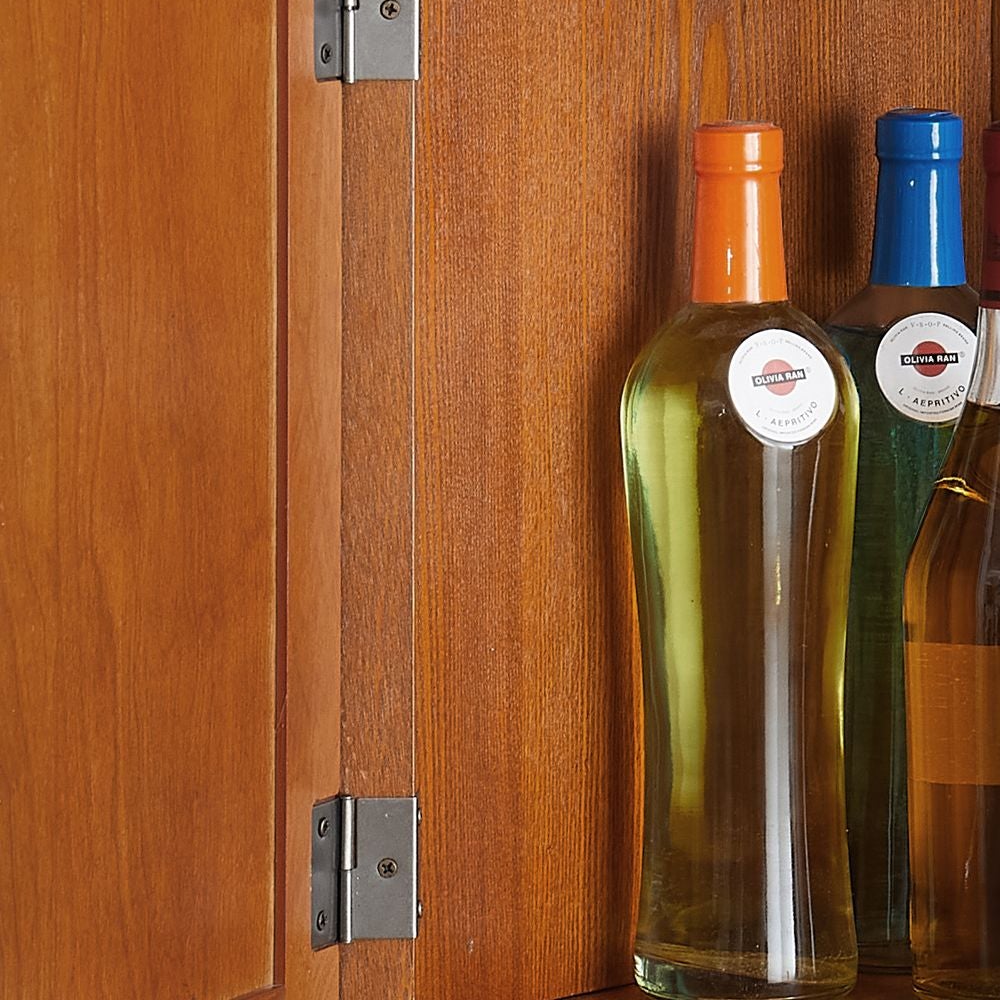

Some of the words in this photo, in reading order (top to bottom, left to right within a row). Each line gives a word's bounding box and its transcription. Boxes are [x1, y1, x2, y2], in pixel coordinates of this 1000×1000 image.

[903, 356, 934, 364] OLIVIA
[936, 354, 956, 362] RAN
[754, 373, 785, 385] OLIVIA
[785, 371, 805, 380] RAN
[913, 385, 966, 407] AEPRITIVO
[770, 401, 817, 427] AEPRITIVO
